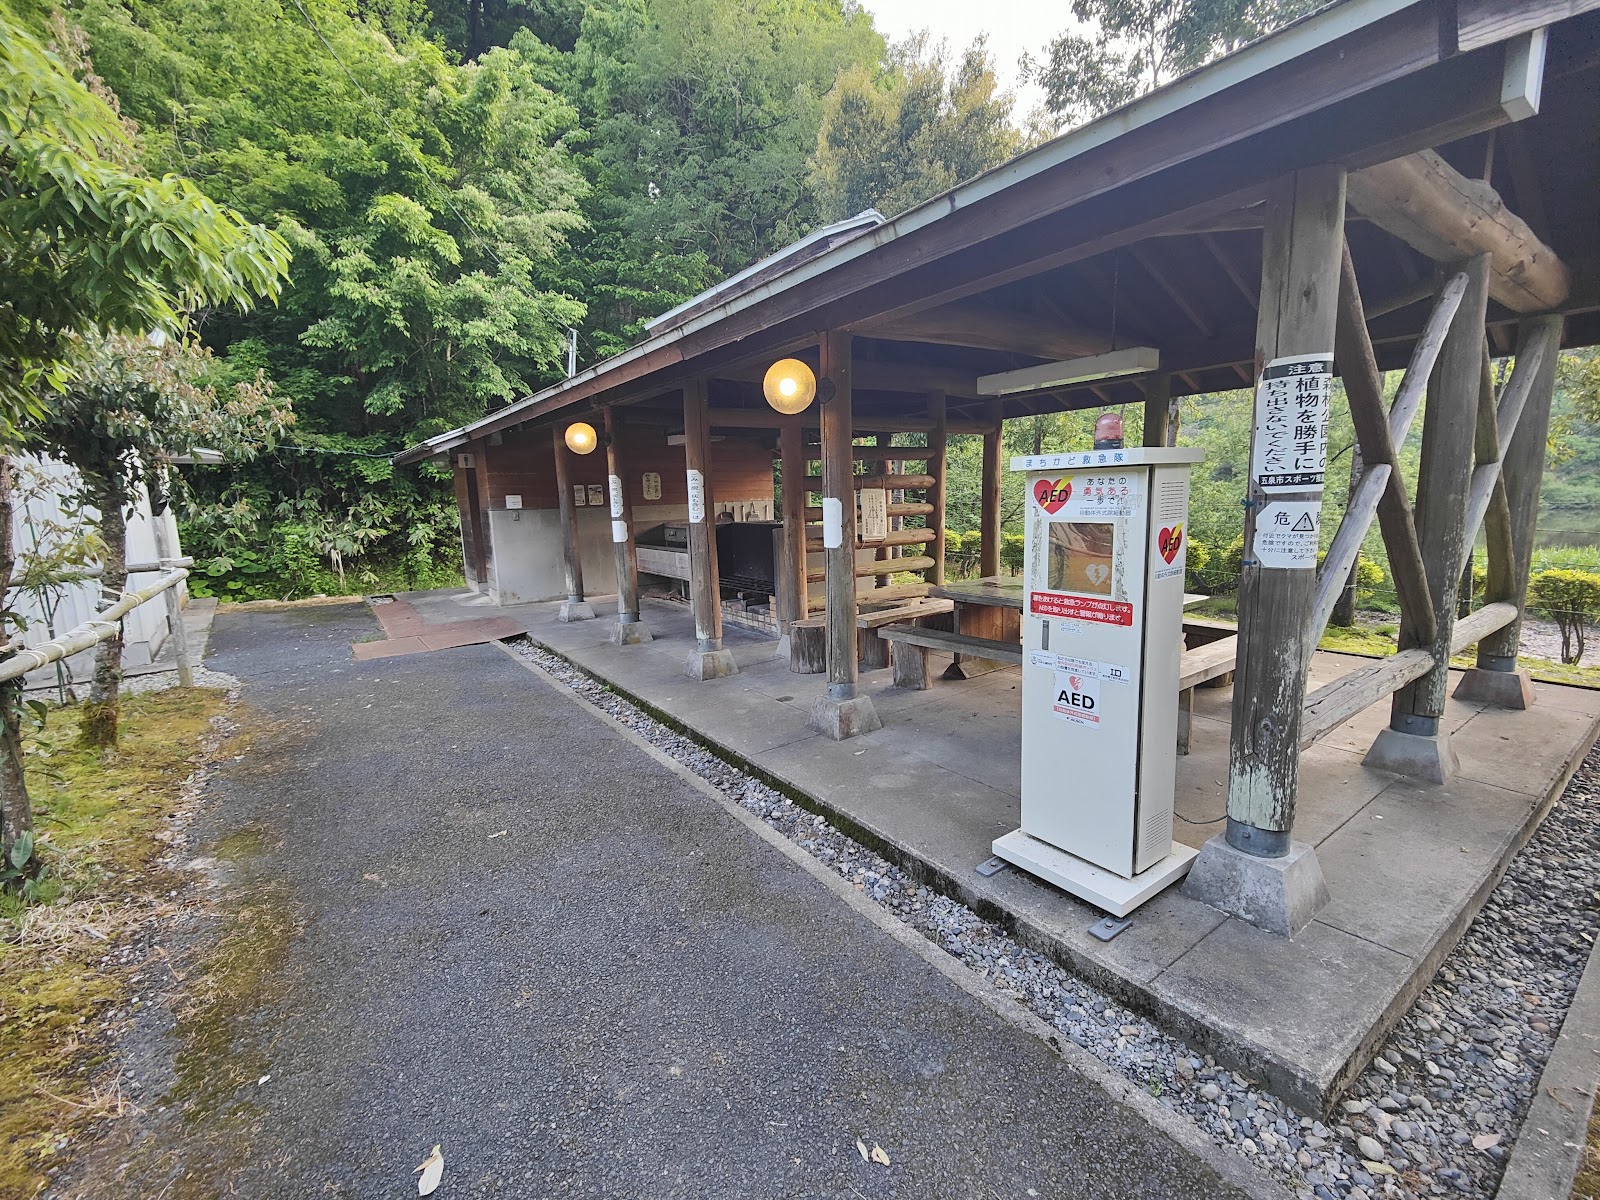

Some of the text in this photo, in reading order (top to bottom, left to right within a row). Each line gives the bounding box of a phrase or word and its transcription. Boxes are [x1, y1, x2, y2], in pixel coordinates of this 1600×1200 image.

[1288, 362, 1324, 375] 注意
[1264, 380, 1289, 472] 持ち出さないでください
[1293, 376, 1320, 470] 植物を勝手に
[1025, 453, 1124, 467] まちかど救急隊
[1086, 477, 1126, 486] あなたの
[1039, 489, 1069, 503] AED
[1083, 486, 1128, 496] 勇気ある
[1161, 537, 1180, 552] AED
[1057, 690, 1095, 709] AED
